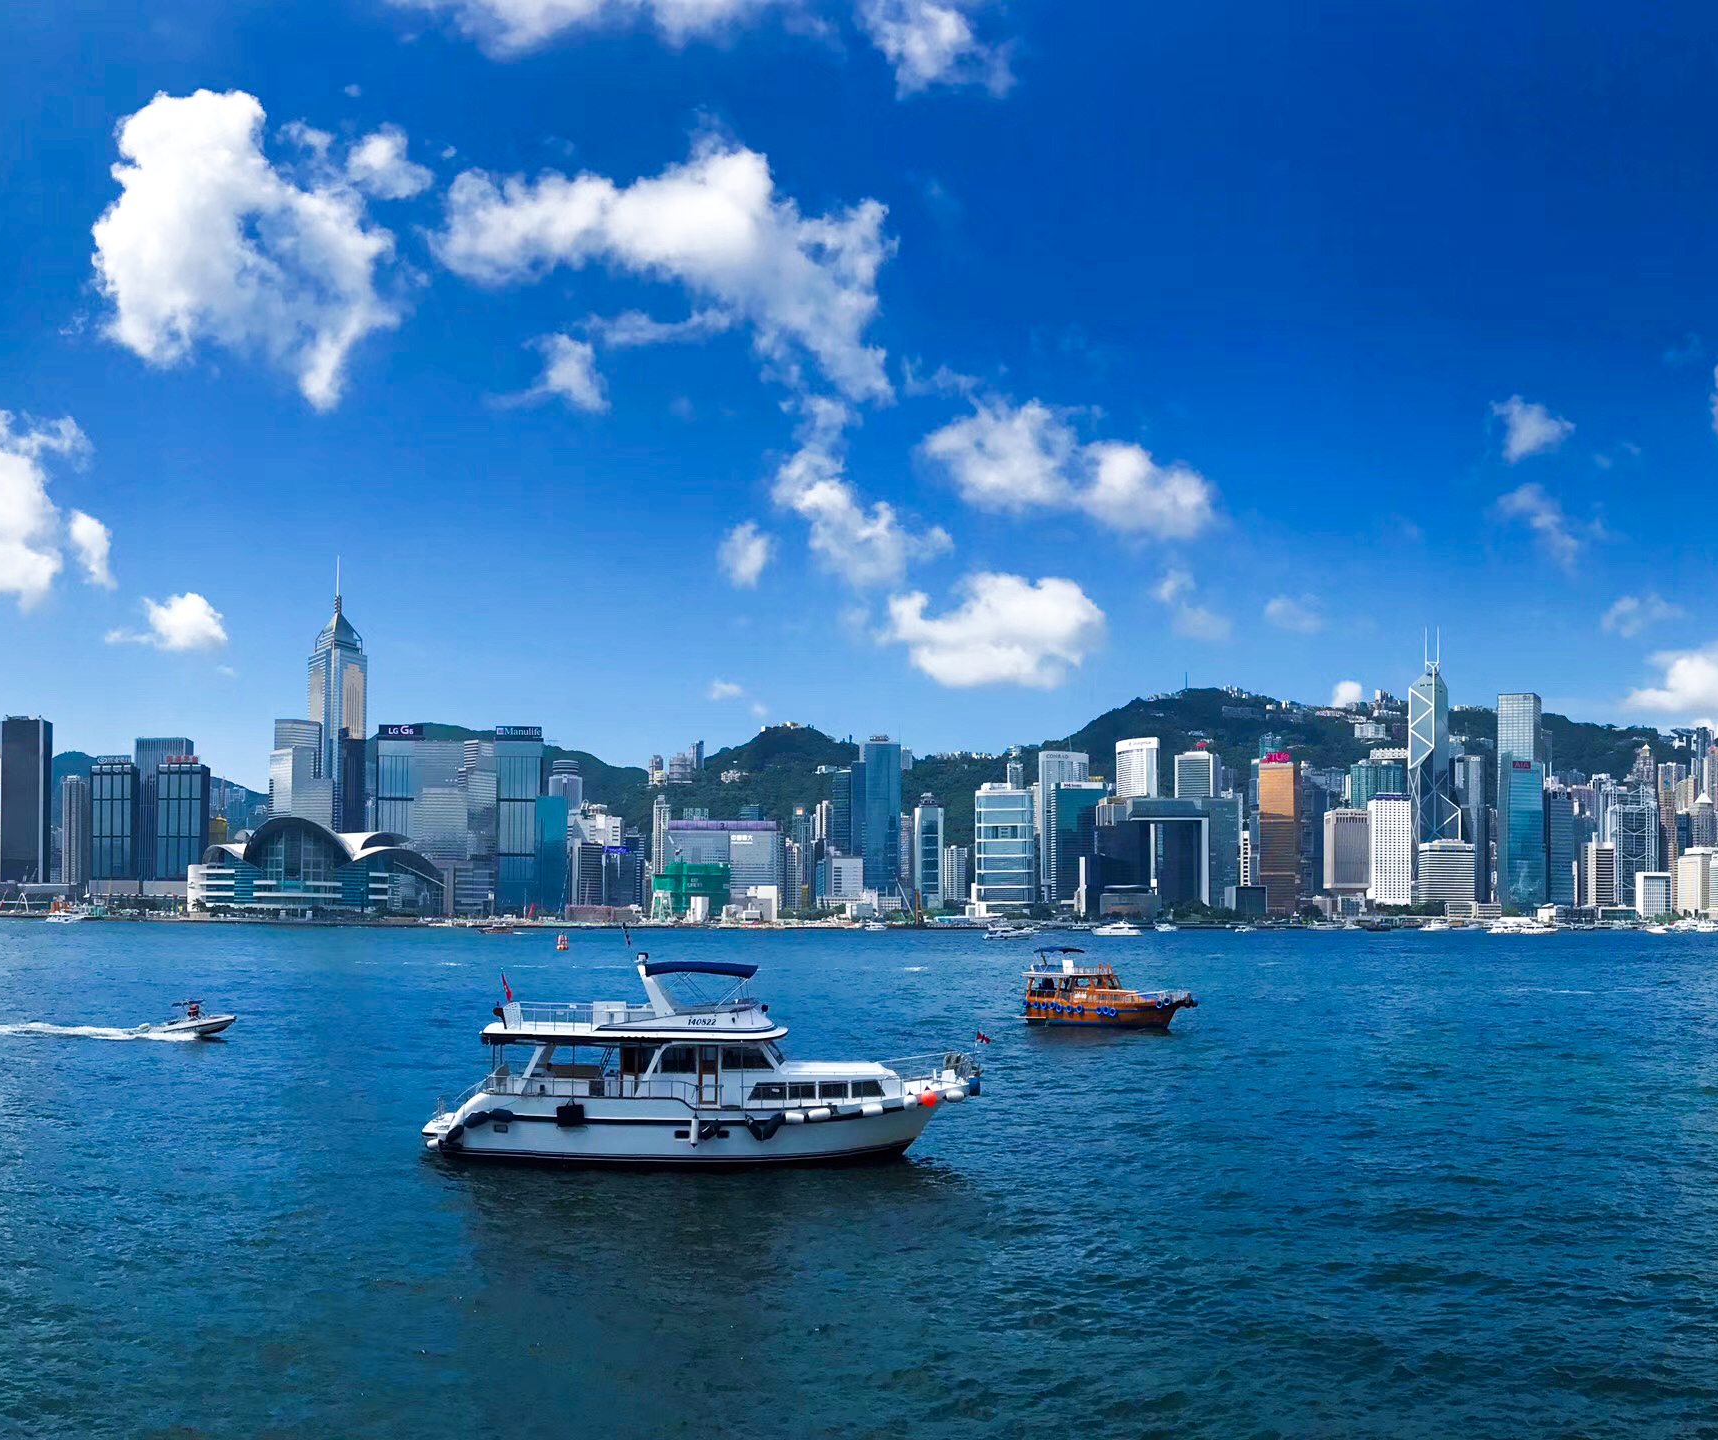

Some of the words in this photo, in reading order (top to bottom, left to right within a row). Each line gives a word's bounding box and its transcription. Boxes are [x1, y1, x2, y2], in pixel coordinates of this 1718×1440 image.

[388, 727, 399, 735] LG
[400, 725, 414, 735] G6
[504, 727, 541, 736] Manulife
[687, 1018, 717, 1026] 140822
